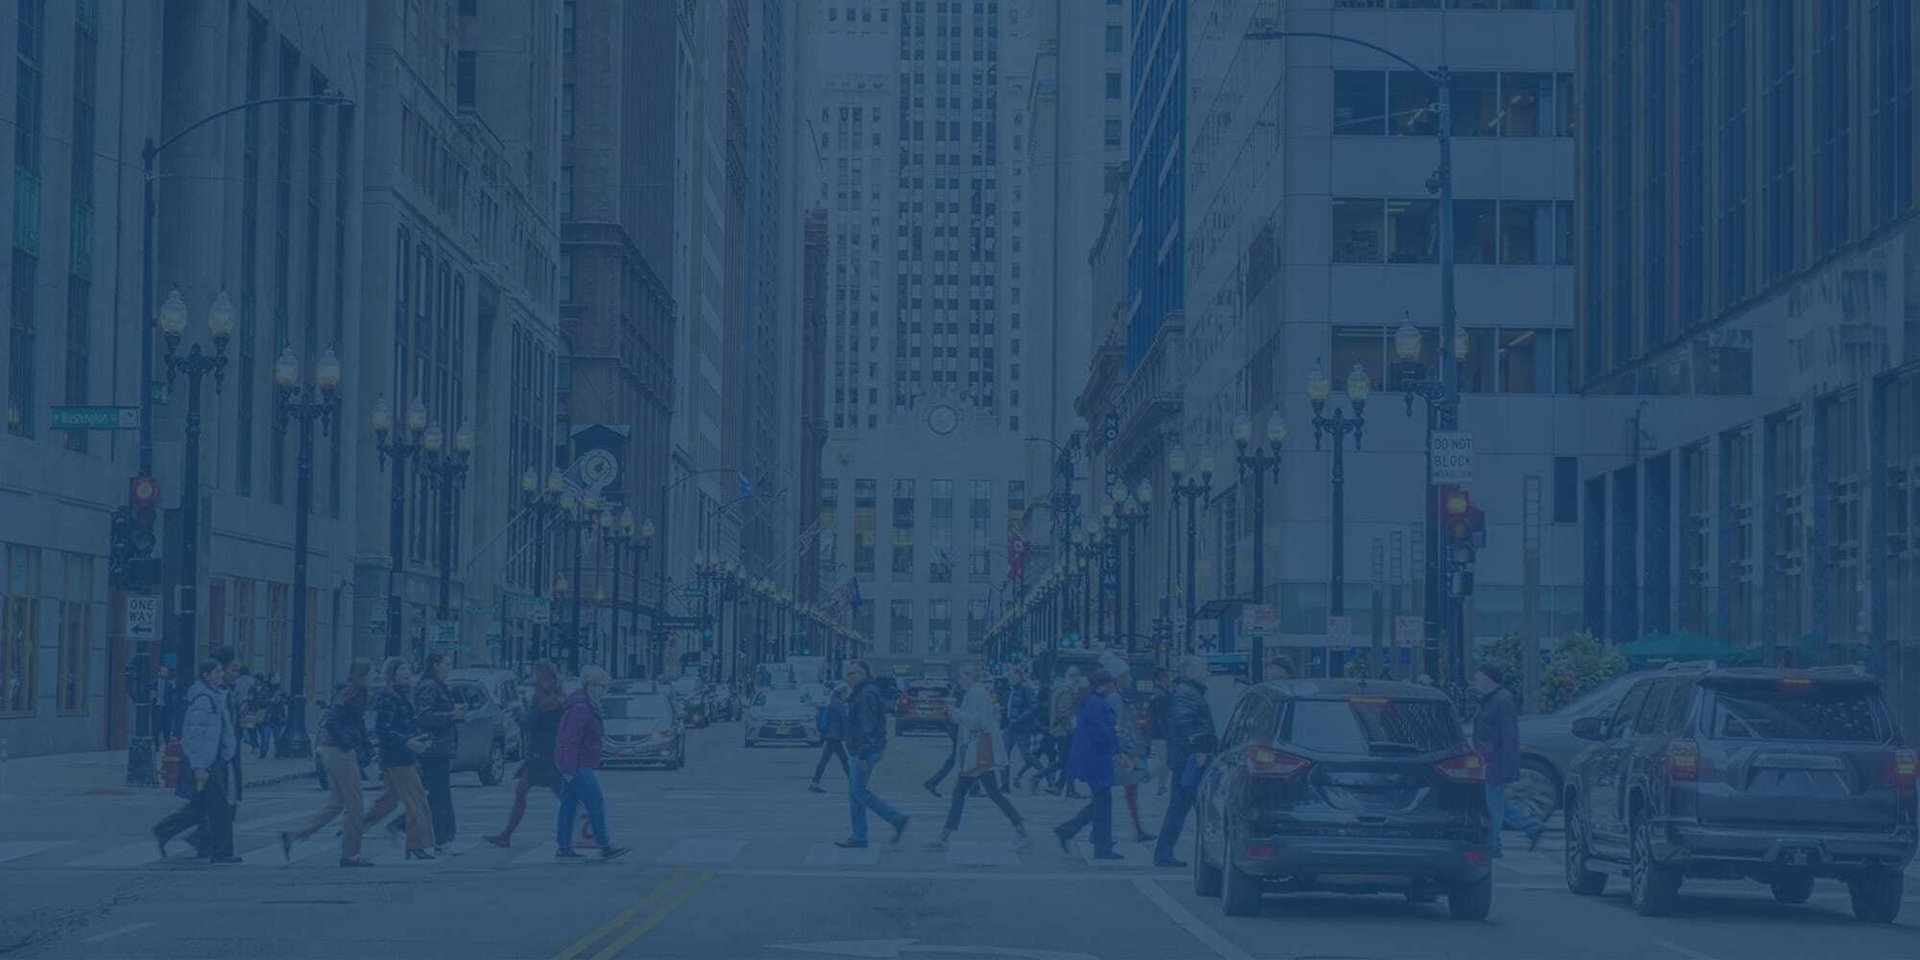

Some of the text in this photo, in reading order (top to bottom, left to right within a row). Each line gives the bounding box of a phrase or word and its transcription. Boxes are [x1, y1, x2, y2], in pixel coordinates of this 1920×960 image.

[1434, 438, 1472, 450] DO NOT
[1434, 455, 1472, 467] BLOCK
[130, 599, 154, 611] ONE
[129, 611, 154, 624] WAY
